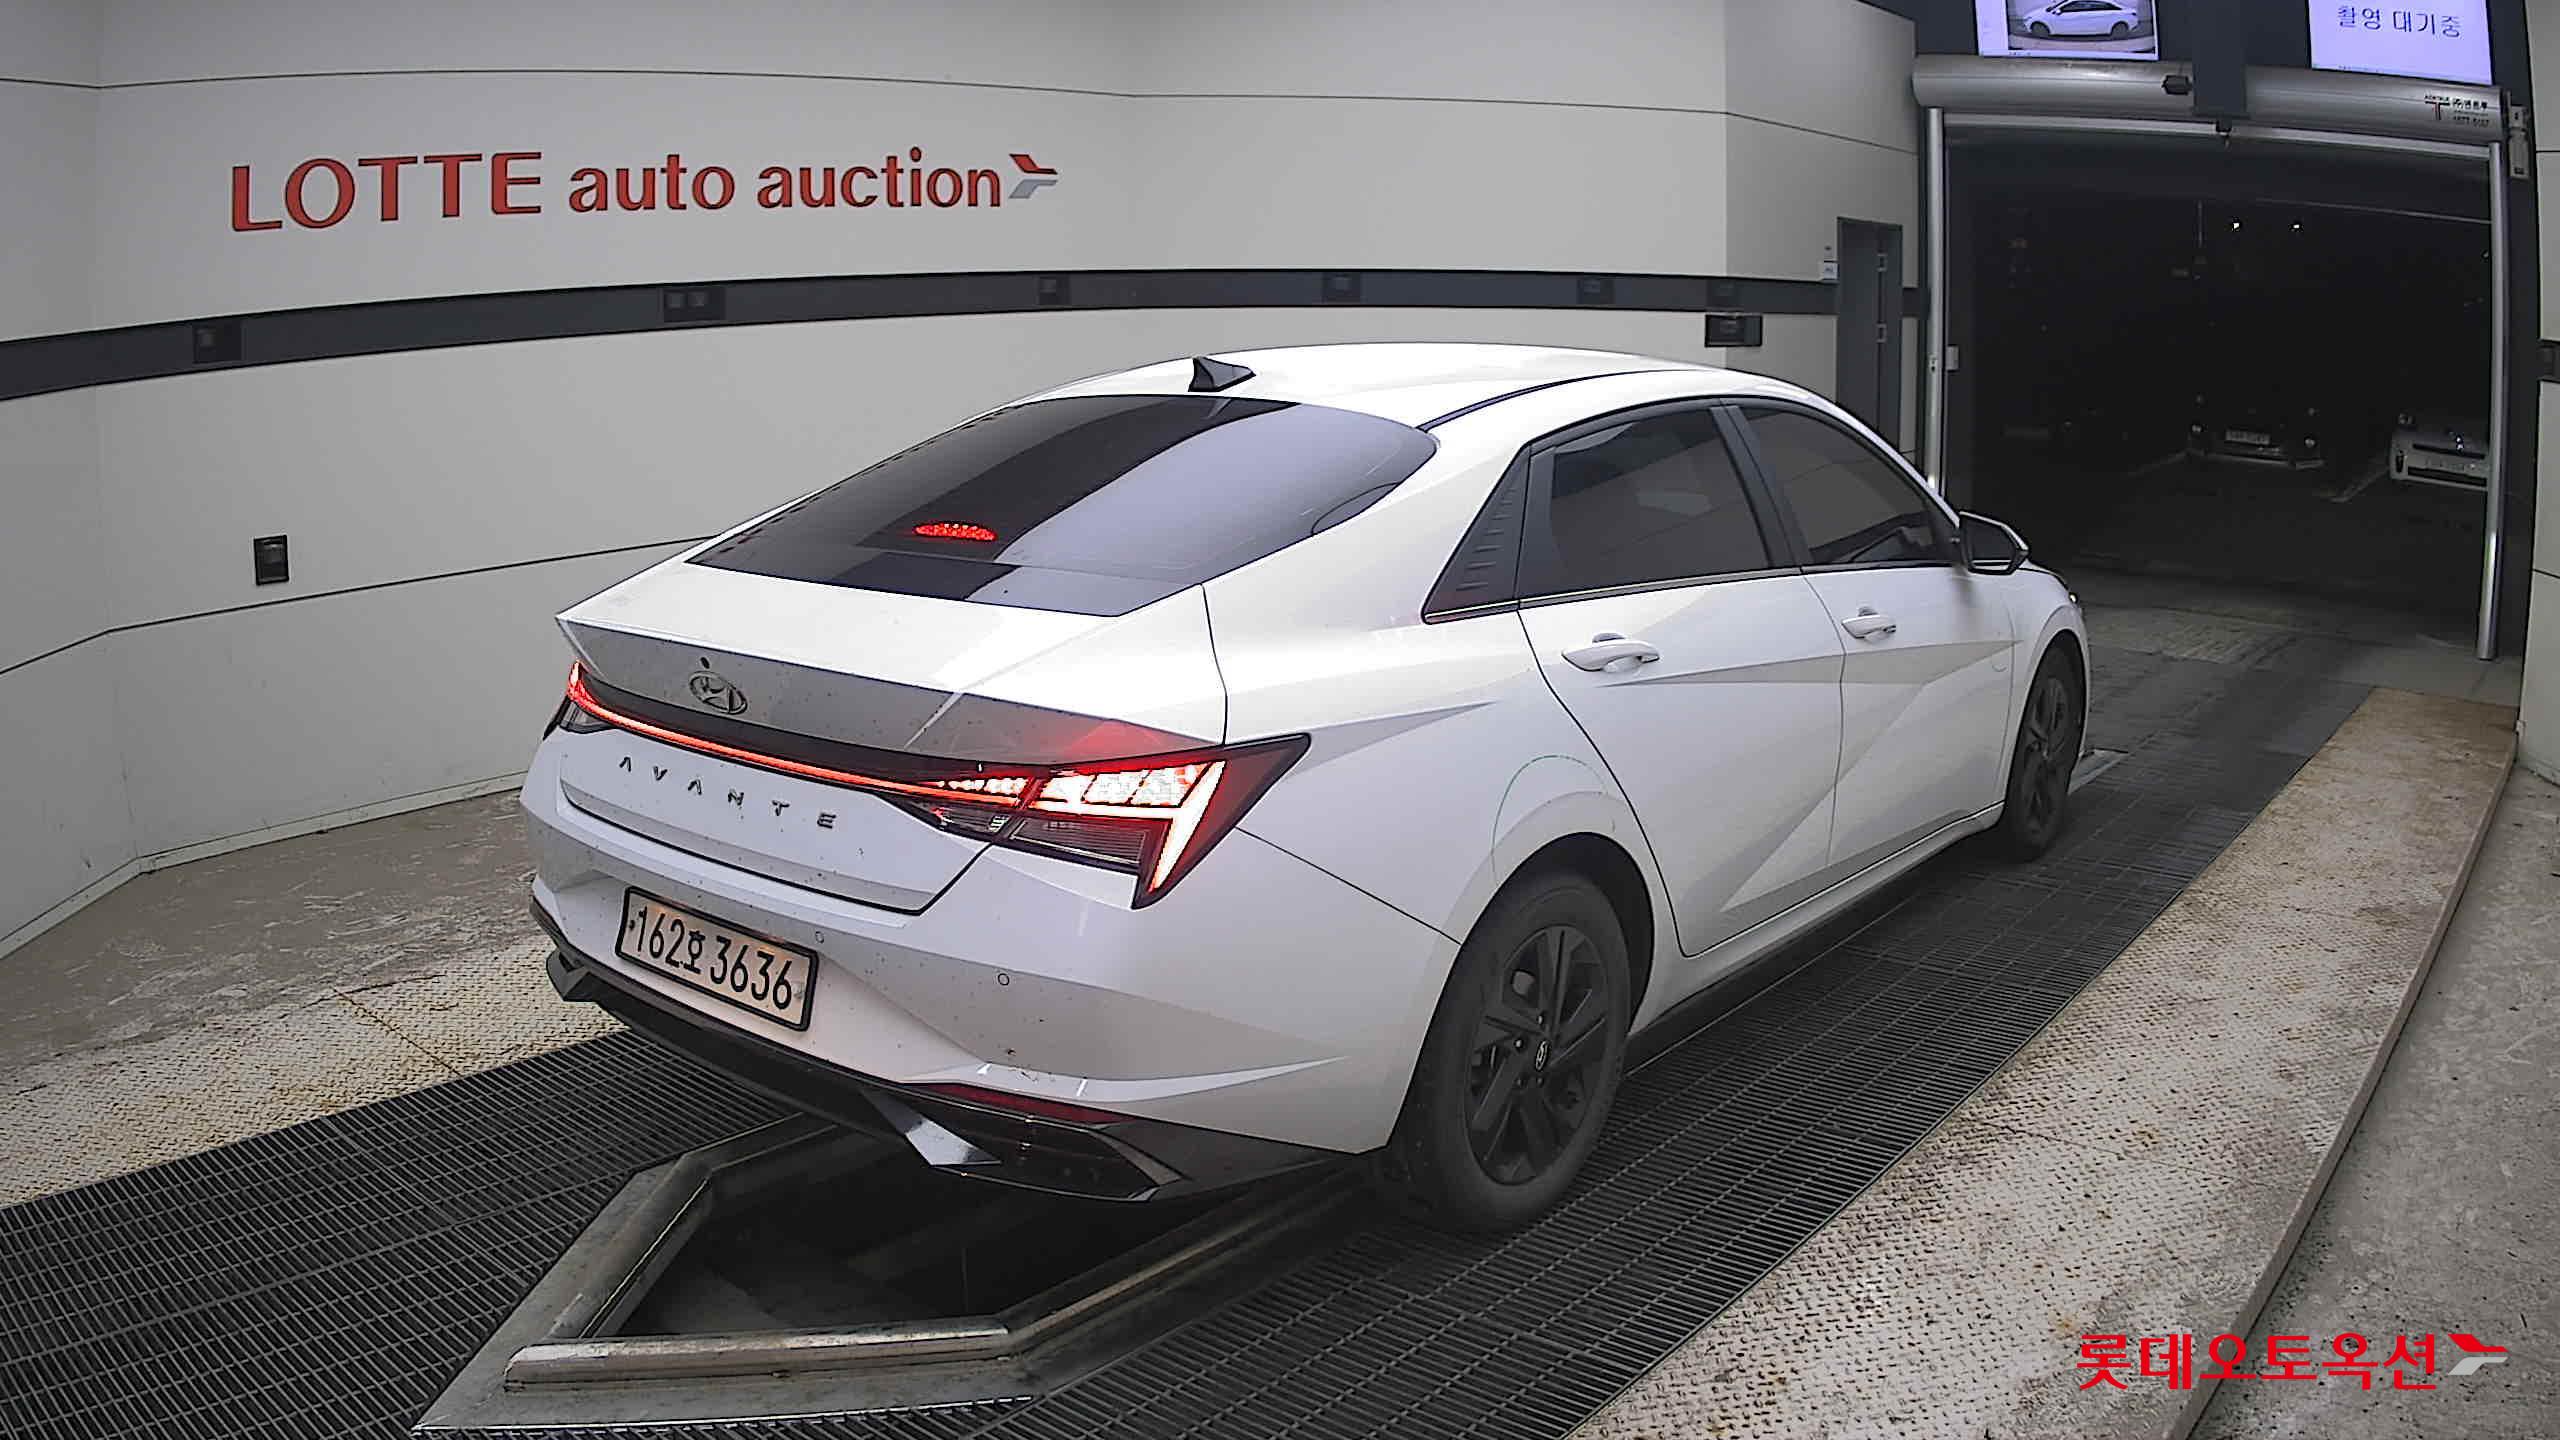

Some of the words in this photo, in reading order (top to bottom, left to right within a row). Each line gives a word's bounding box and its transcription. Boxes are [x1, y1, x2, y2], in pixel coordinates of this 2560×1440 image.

[2338, 6, 2382, 31] 촬영
[2392, 10, 2461, 38] 대기중
[231, 151, 542, 232] LOTTE
[568, 153, 736, 213] auto
[756, 146, 1001, 209] auction
[619, 756, 837, 829] AVANTE
[637, 906, 706, 975] 162호
[709, 934, 793, 1010] 3636
